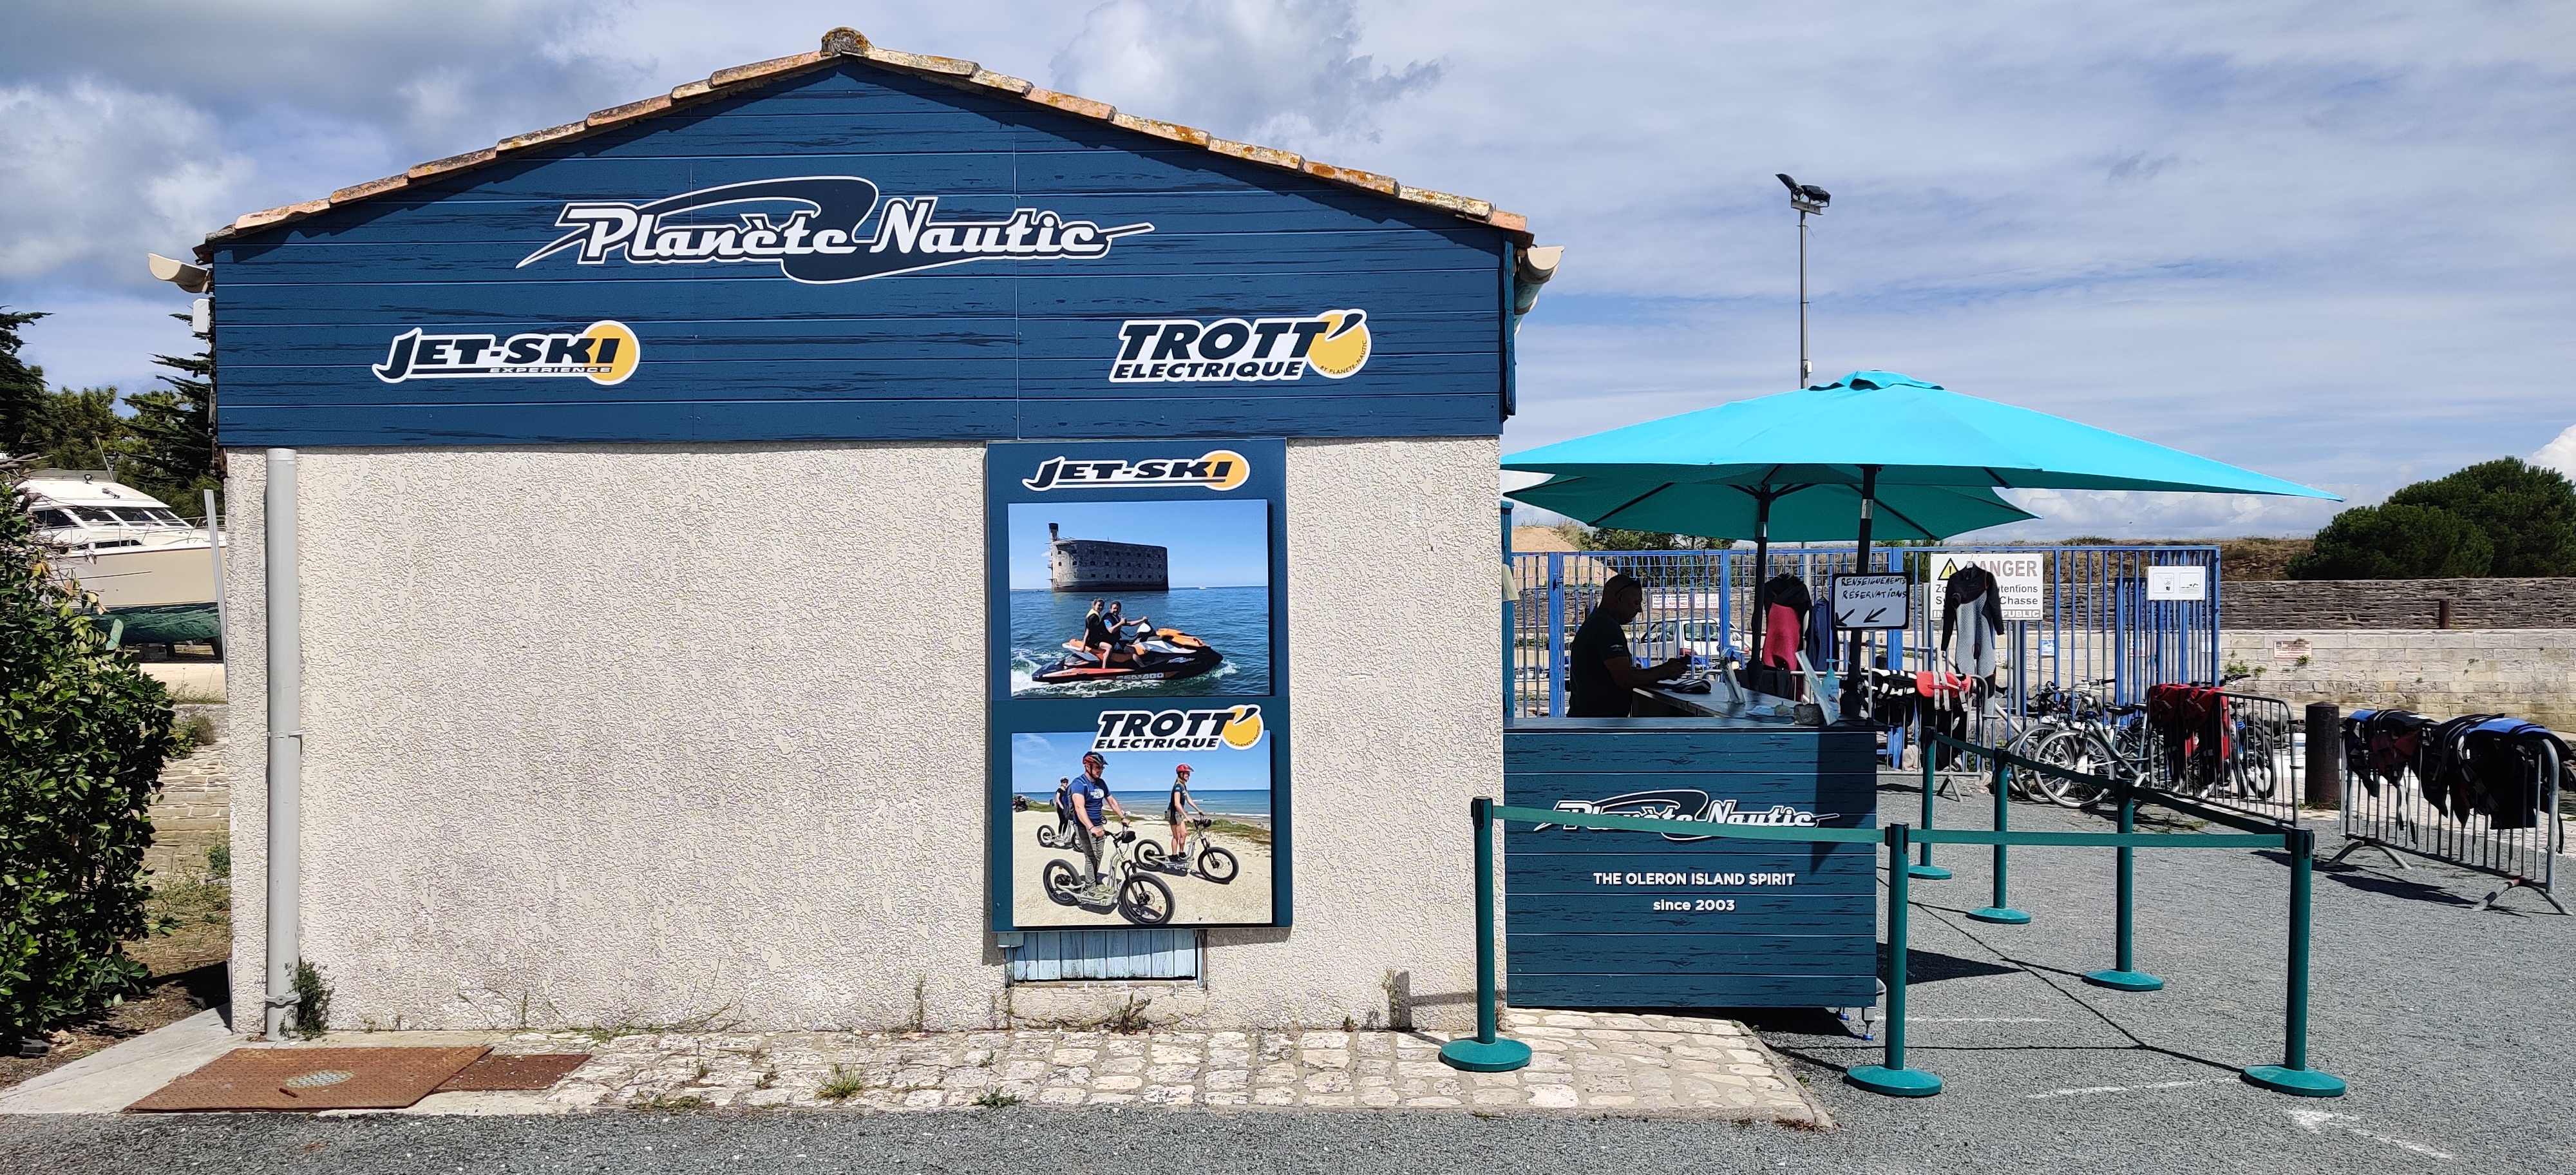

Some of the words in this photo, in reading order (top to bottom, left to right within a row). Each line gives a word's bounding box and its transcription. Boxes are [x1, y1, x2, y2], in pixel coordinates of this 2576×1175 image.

[559, 204, 858, 261] Planète
[871, 198, 1108, 258] Nautic
[375, 330, 621, 379] JET-SKI
[1113, 361, 1303, 379] ELECTRIQUE
[1025, 460, 1233, 488] JET-SKI
[1979, 560, 2038, 577] ANGER
[2000, 596, 2038, 605] Chasse
[1094, 738, 1219, 749] ELECTRIQUE
[1707, 801, 1817, 827] Nautic
[1593, 872, 1622, 885] THE
[1625, 872, 1687, 886] OLERON
[1691, 872, 1745, 886] ISLAND
[1749, 873, 1795, 886] SPIRIT
[1653, 898, 1691, 911] since
[1695, 899, 1736, 911] 2003
